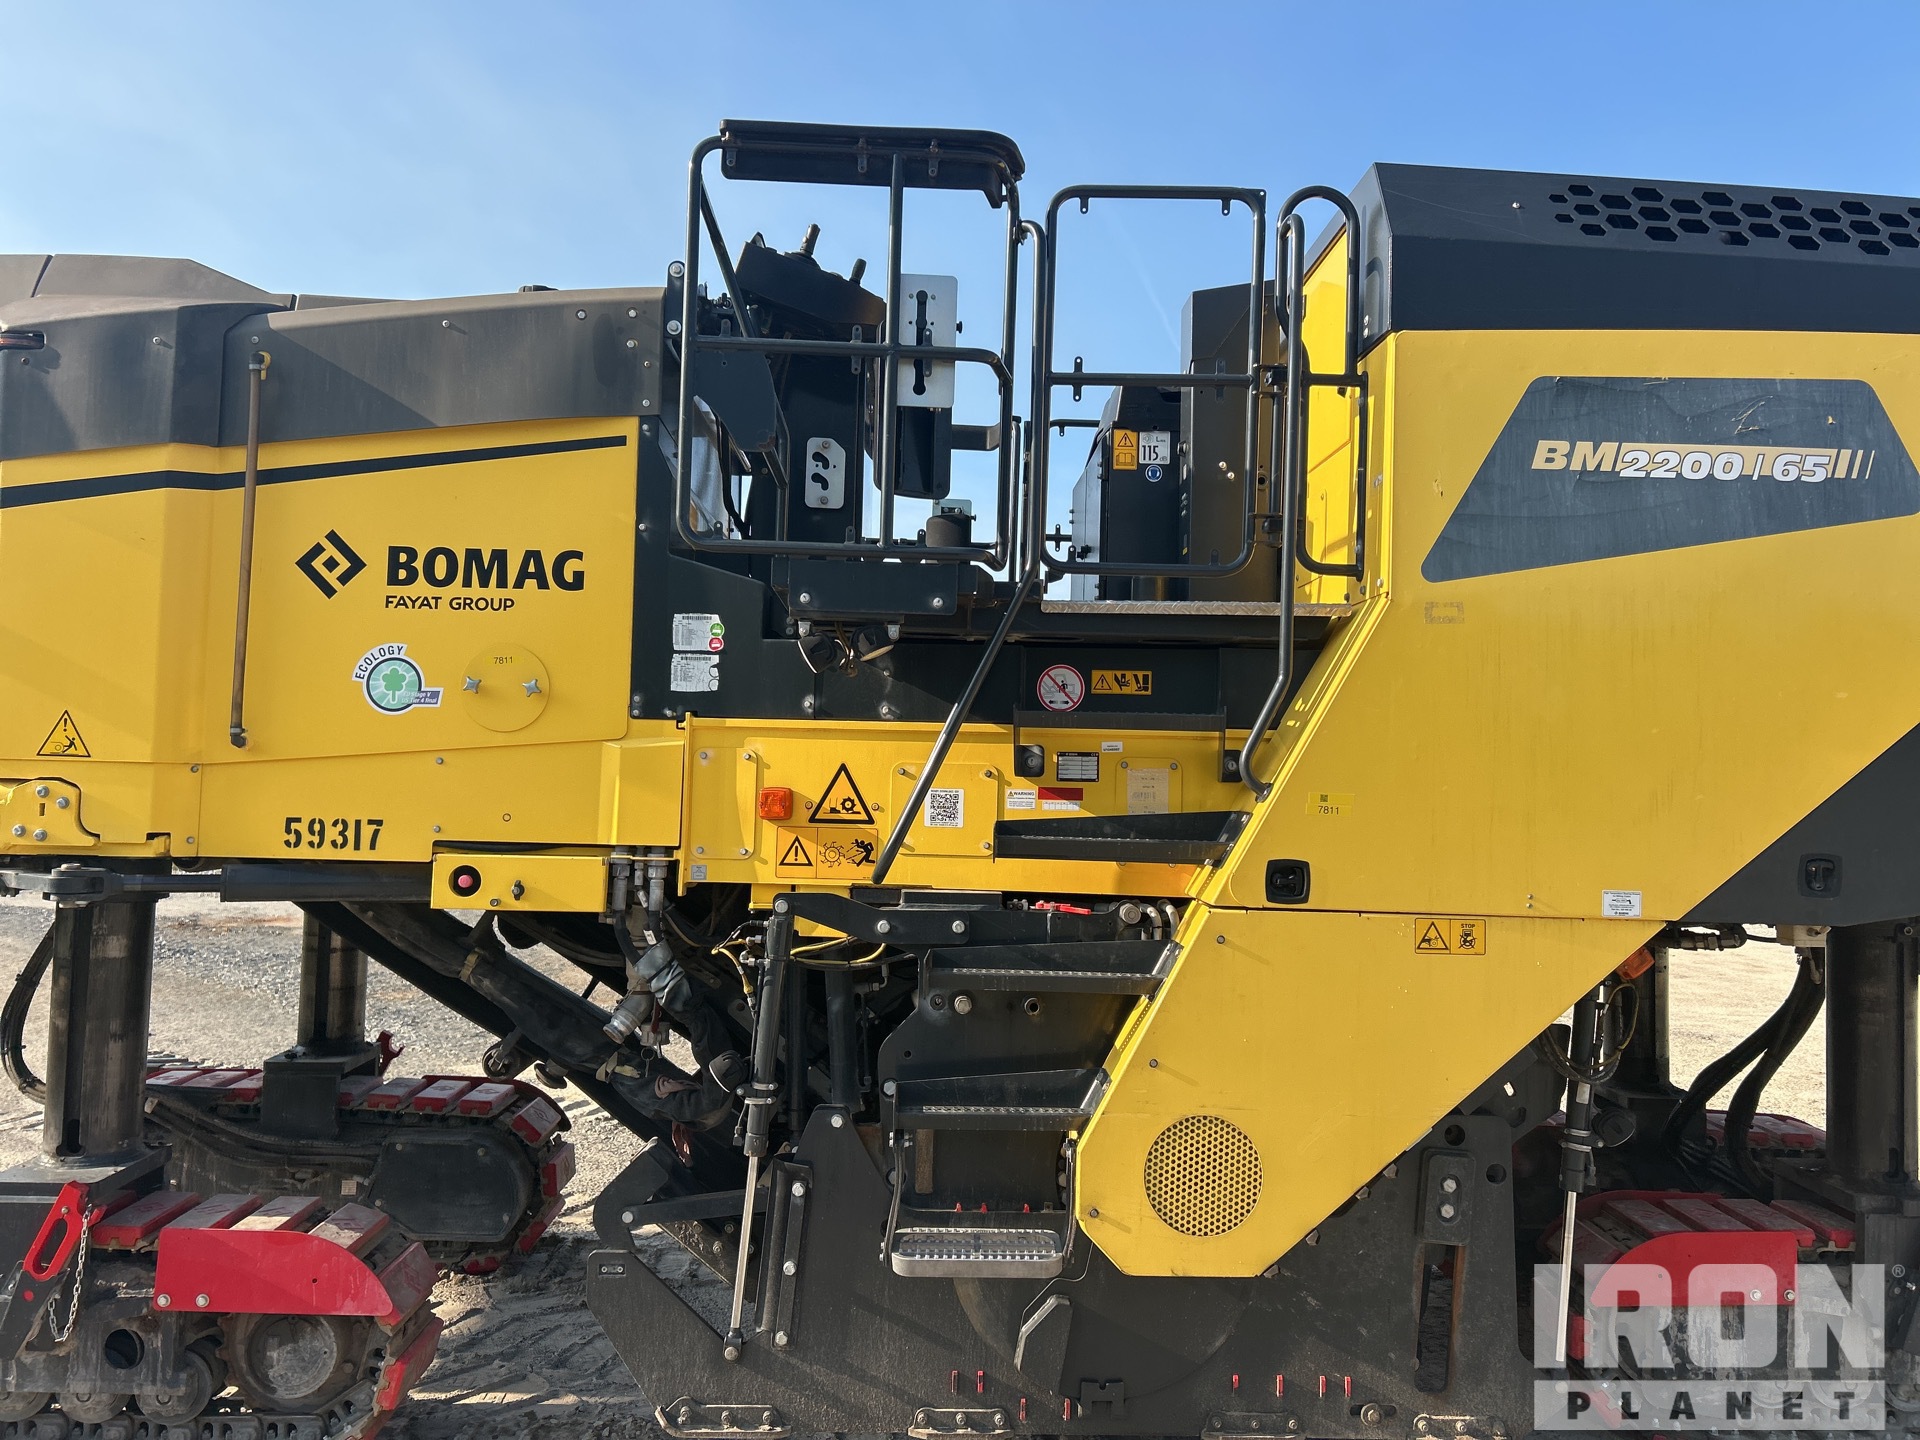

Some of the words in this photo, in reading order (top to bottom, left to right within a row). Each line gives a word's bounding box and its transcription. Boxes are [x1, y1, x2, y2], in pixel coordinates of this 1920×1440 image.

[1141, 445, 1159, 461] 115
[386, 545, 585, 592] BOMAG
[384, 595, 442, 610] FAYAT
[448, 597, 515, 612] GROUP
[354, 645, 405, 680] ECOLOGY
[493, 656, 513, 665] 7811
[411, 691, 426, 699] Stage
[1318, 805, 1339, 815] 7811
[283, 816, 384, 851] 59317
